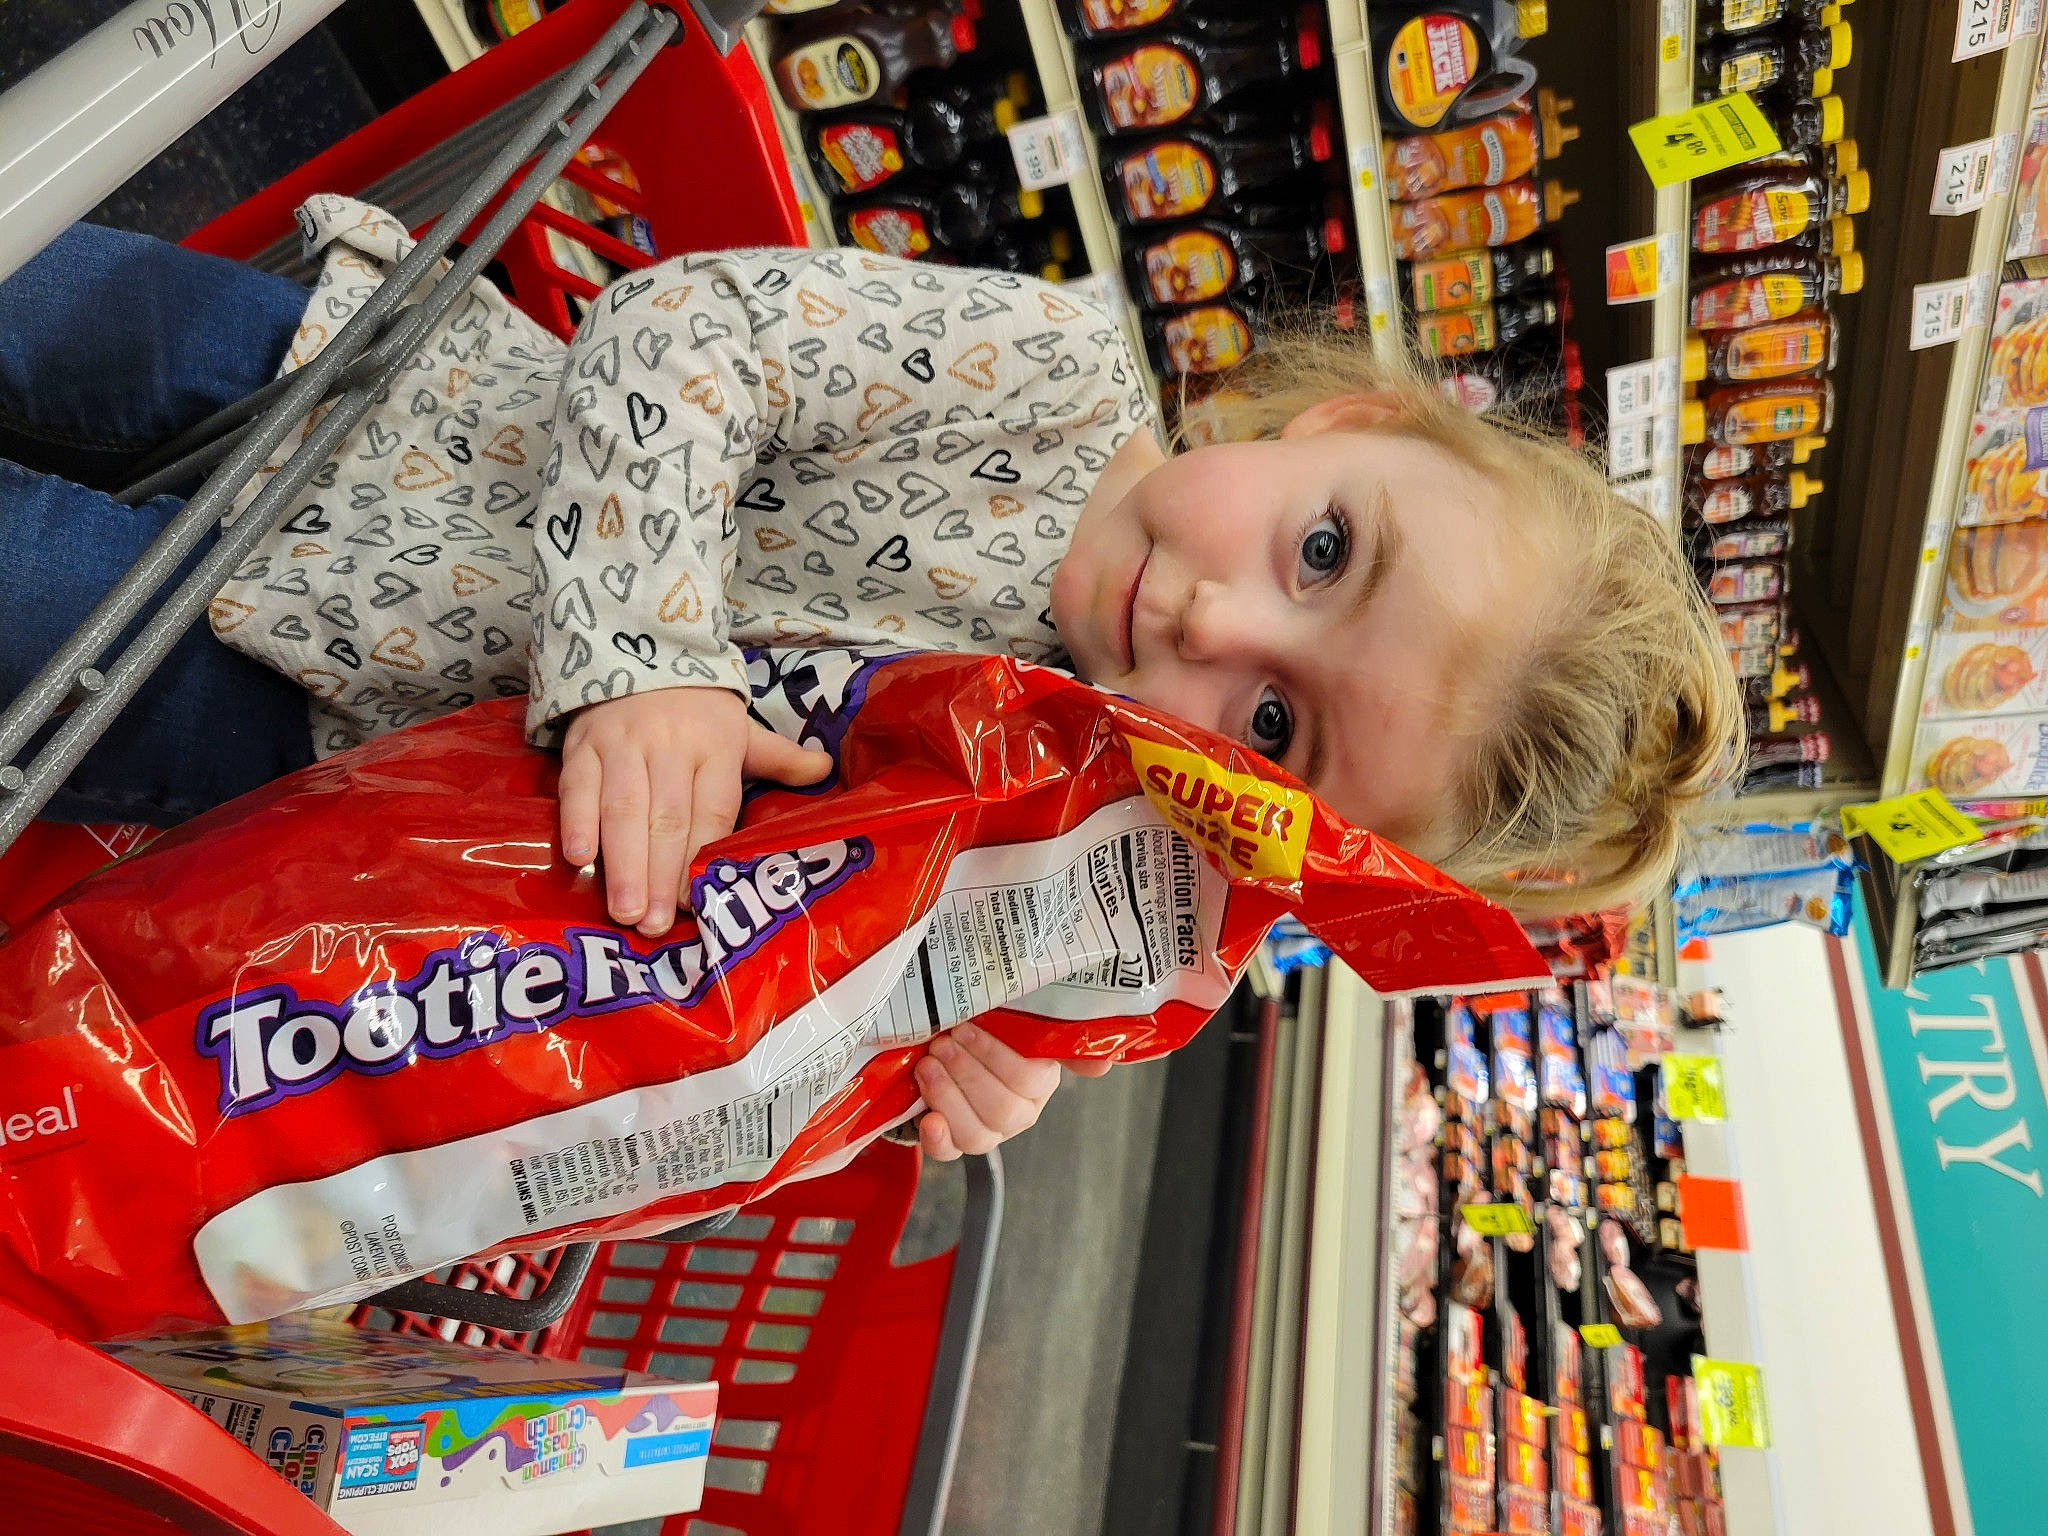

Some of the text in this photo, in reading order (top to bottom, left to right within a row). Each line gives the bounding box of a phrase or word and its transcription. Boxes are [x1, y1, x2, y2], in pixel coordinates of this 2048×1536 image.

[1426, 24, 1453, 93] JACK
[1146, 764, 1294, 842] SUPER
[1135, 829, 1149, 869] Serving
[1138, 870, 1150, 891] size
[1151, 829, 1172, 970] About 20 servings per container
[973, 900, 996, 972] Dietary Fiber 1g
[989, 891, 1016, 981] Total Carbohydrate
[1006, 889, 1028, 960] Sodium 190mg
[1093, 844, 1145, 989] Calories 170
[929, 937, 940, 951] 2g
[942, 912, 968, 1005] Includes 18g Added
[958, 911, 982, 988] Total Sugars 19g
[1147, 928, 1158, 950] cup
[1176, 914, 1199, 968] Facts
[202, 948, 566, 1098] Tootie
[540, 1152, 564, 1188] (Vitamin
[558, 1147, 579, 1184] (Vitamin
[574, 1141, 594, 1176] (source
[509, 1159, 533, 1201] CONTAINS
[531, 1171, 554, 1207] (Vitamin
[380, 1214, 402, 1243] POST
[524, 1406, 586, 1446] Crunch
[536, 1430, 575, 1461] Toast
[386, 1439, 416, 1456] TOPS
[388, 1448, 418, 1470] BOX
[338, 1479, 416, 1499] NO MORE CLIPPING
[345, 1463, 380, 1479] SCAN
